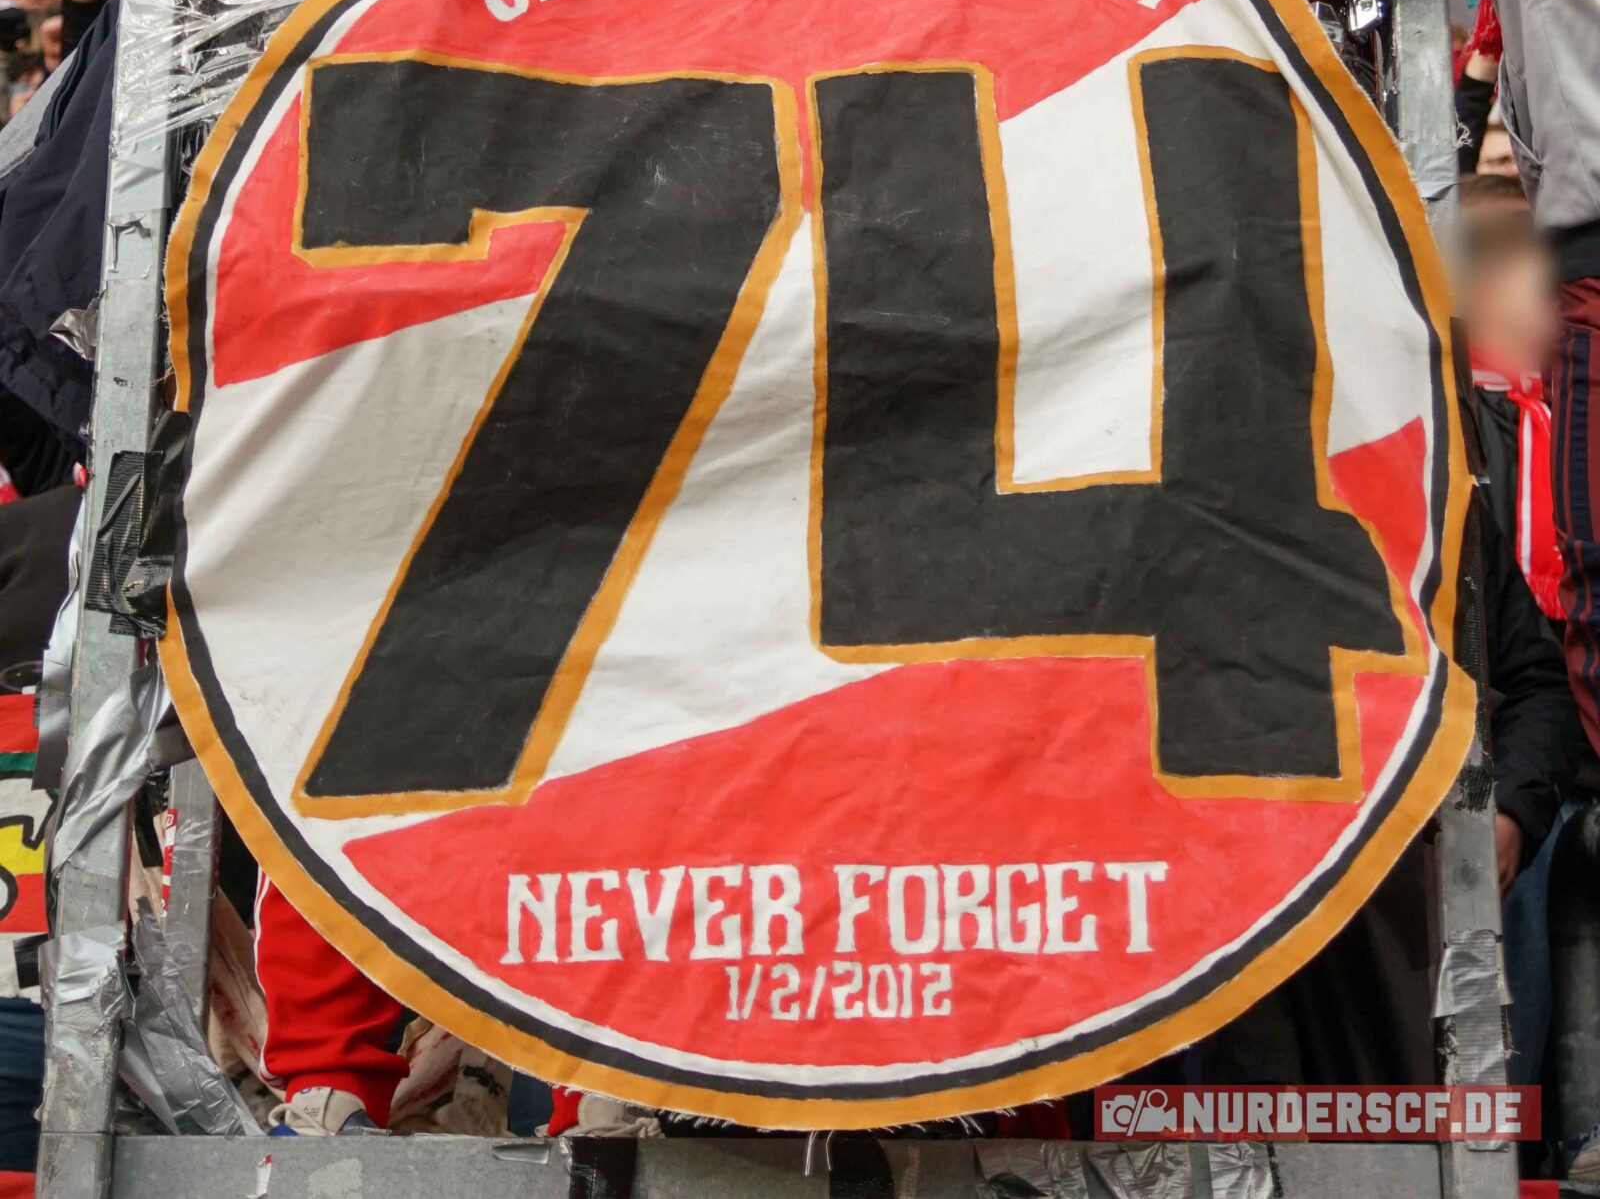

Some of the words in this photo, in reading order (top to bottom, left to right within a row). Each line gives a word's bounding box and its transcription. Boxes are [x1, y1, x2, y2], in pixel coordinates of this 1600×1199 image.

[292, 47, 1428, 819] 74
[501, 864, 805, 966] NEVER
[834, 862, 1170, 956] FORGET
[725, 962, 953, 1022] 1/2/2012
